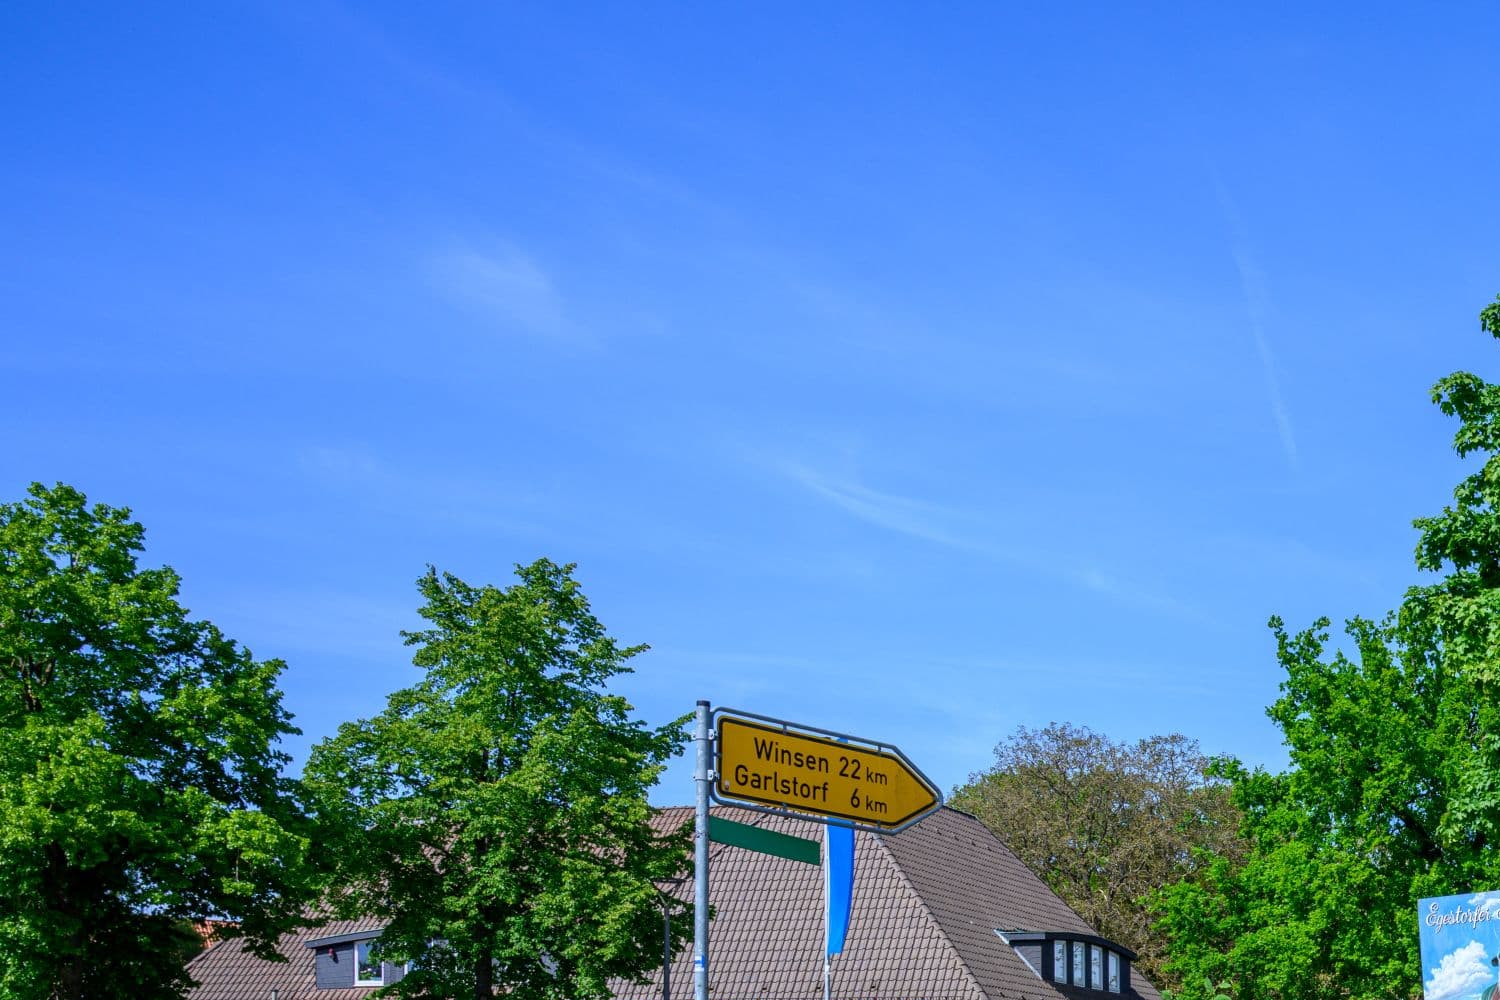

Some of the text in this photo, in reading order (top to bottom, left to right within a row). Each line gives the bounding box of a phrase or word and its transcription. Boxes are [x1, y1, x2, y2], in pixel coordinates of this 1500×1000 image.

[754, 737, 888, 786] Winsen 22 km
[735, 764, 888, 814] Garlstorf 6 km
[1425, 902, 1492, 934] Egestorfer
